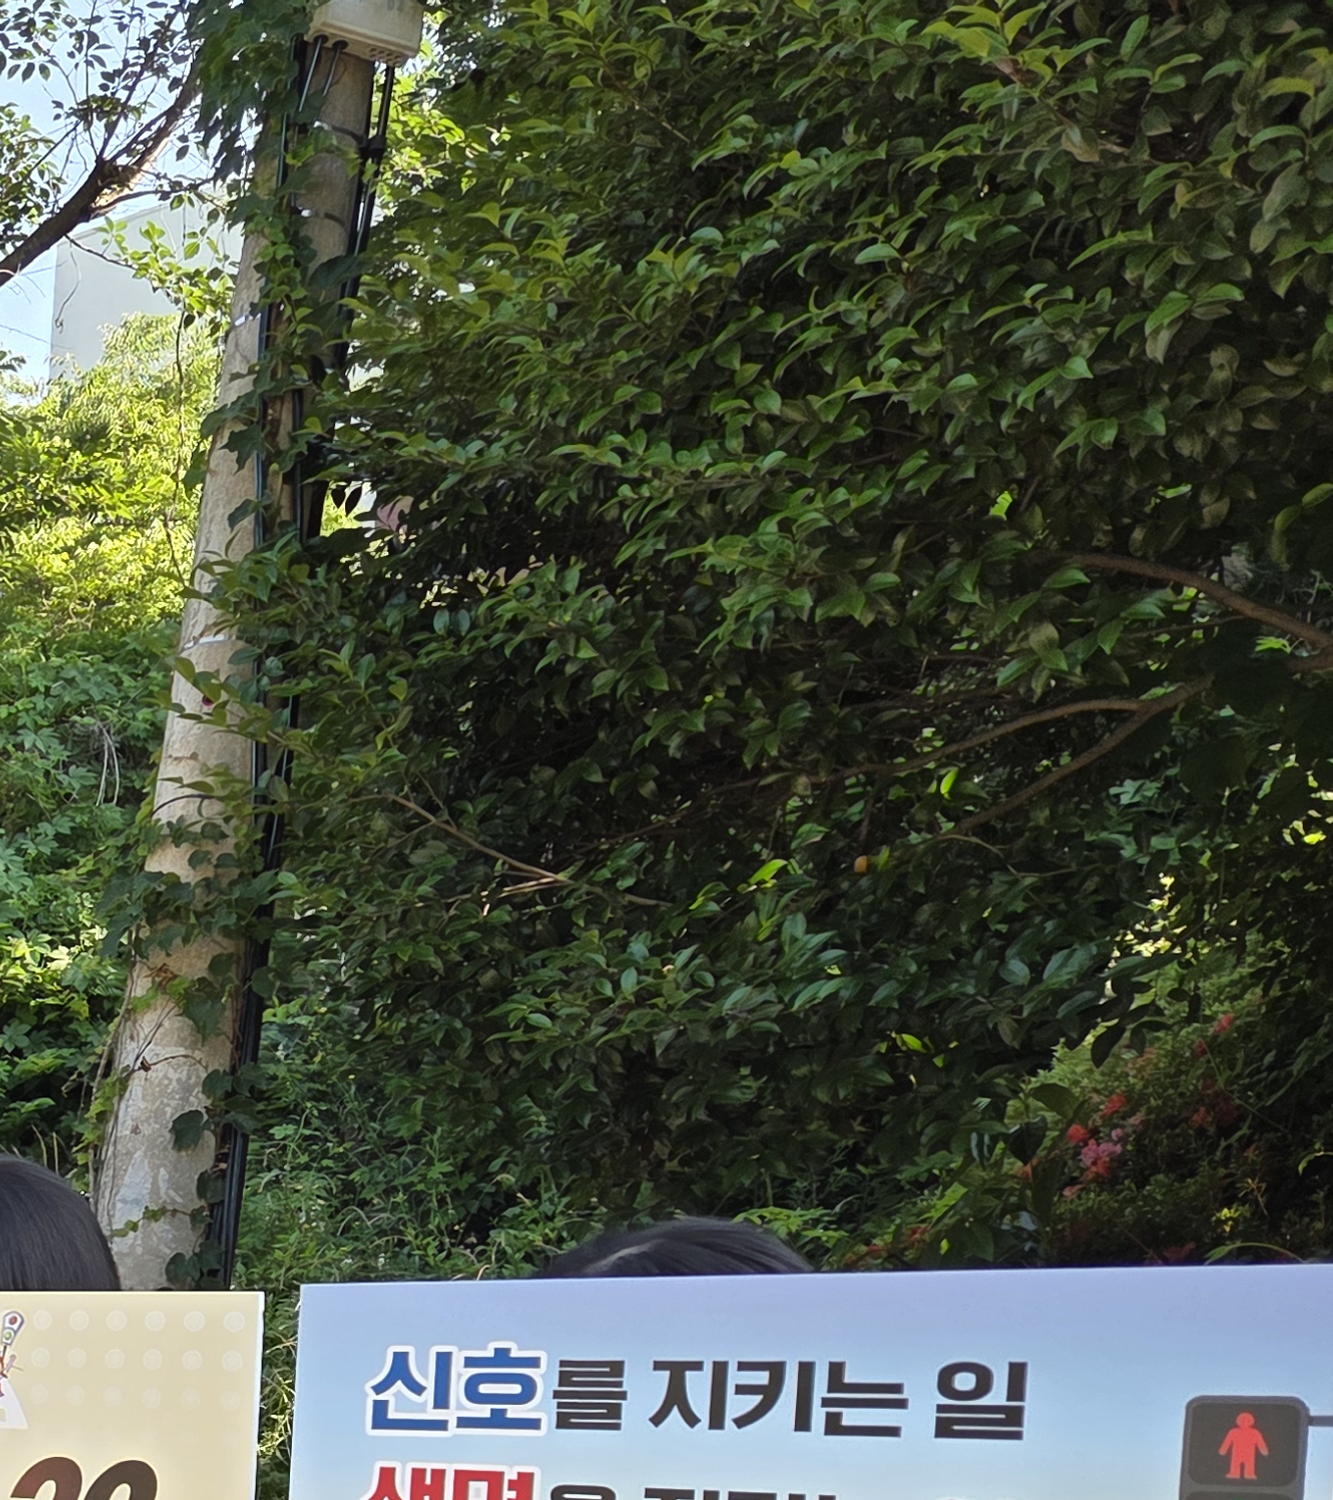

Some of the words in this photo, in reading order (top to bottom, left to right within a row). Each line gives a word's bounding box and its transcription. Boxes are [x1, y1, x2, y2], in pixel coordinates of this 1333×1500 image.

[368, 1342, 629, 1436] 신호를
[648, 1360, 906, 1438] 지키는
[933, 1360, 1030, 1441] 일
